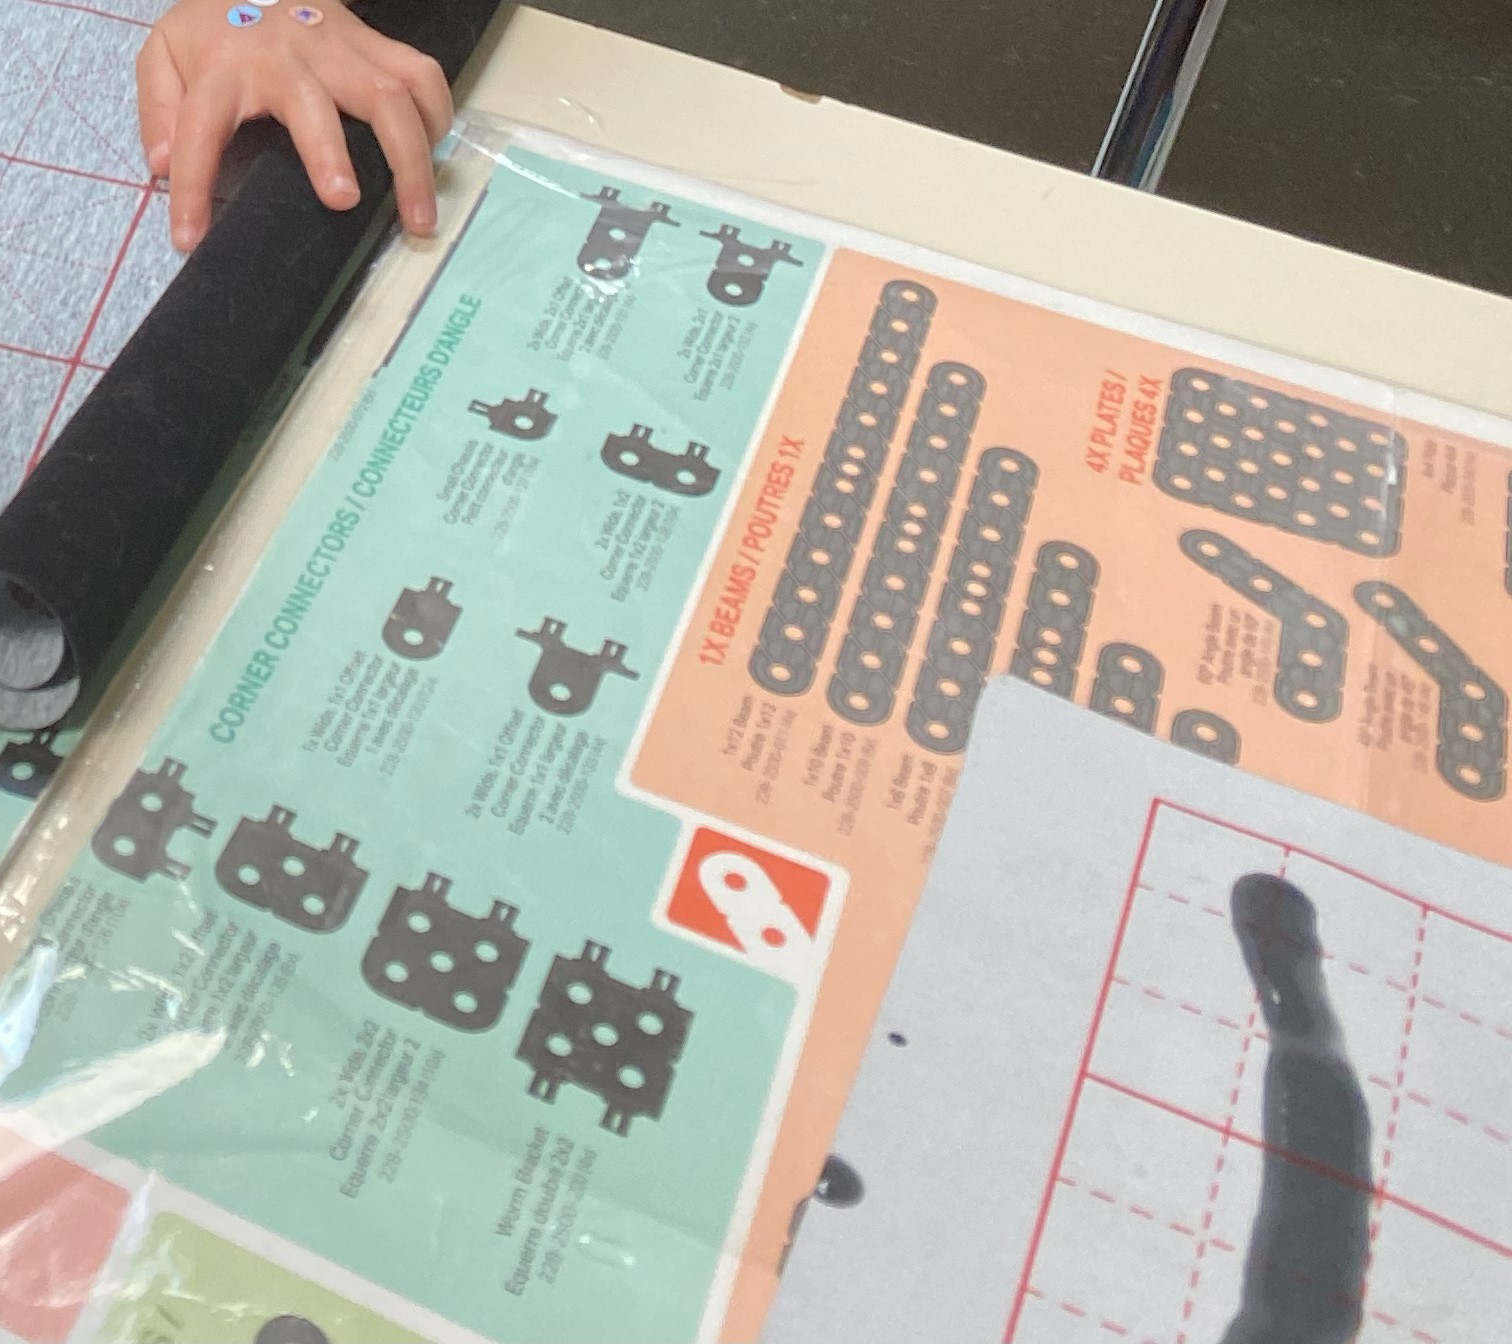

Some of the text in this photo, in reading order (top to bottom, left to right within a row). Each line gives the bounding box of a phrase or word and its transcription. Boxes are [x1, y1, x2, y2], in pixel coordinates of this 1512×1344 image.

[1088, 378, 1127, 447] PLATES
[1116, 374, 1164, 485] PLAQUES 4X
[775, 433, 806, 462] 1X
[1083, 447, 1111, 474] 4X
[206, 647, 280, 748] CORNER
[260, 504, 362, 654] CONNECTORS
[349, 360, 445, 501] CONNECTEURS
[425, 289, 484, 368] D'ANGLE
[740, 458, 797, 553] POUTRES
[707, 561, 758, 639] BEAMS
[696, 636, 730, 669] 1X
[495, 1184, 529, 1239] Worm
